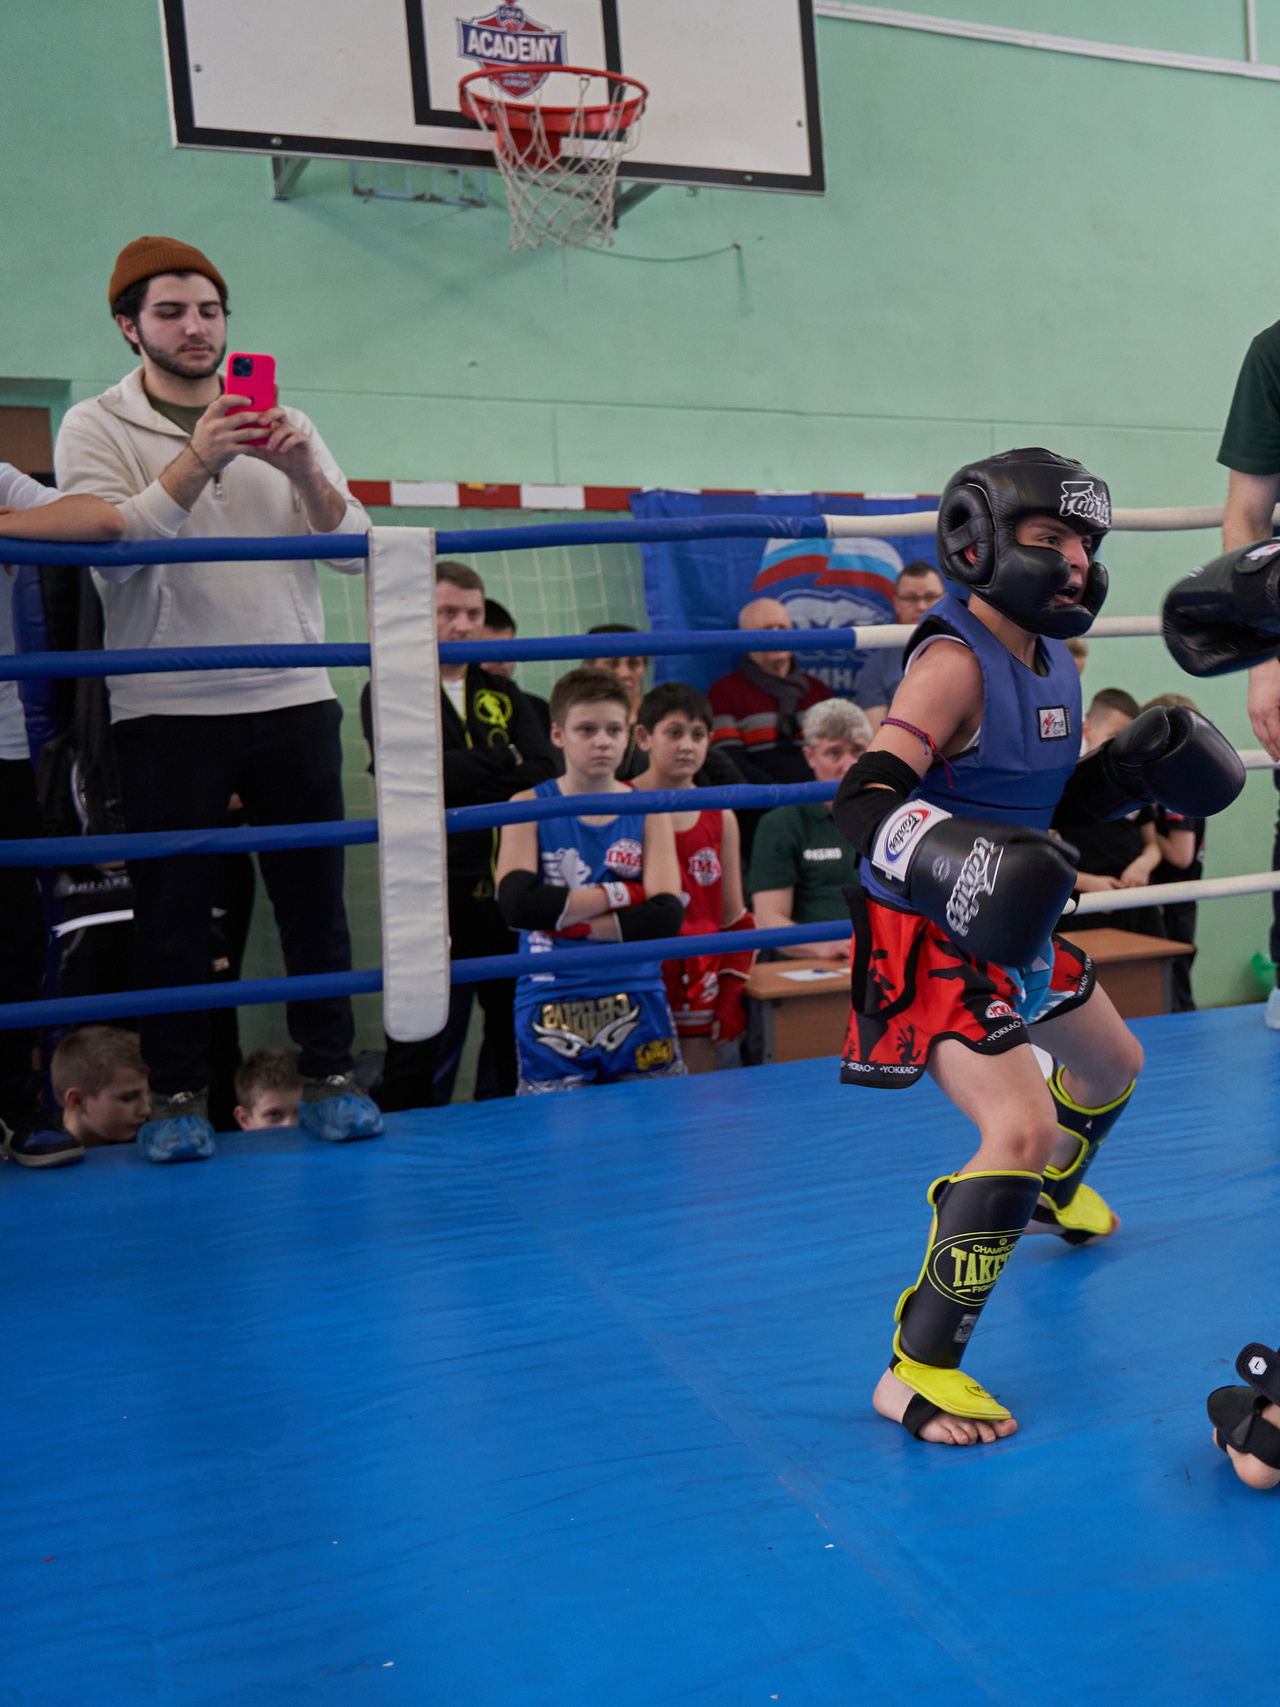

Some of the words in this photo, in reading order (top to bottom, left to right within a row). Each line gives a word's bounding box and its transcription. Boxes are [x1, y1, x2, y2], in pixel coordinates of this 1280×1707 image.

[466, 28, 558, 63] ACADEMY
[989, 1020, 1021, 1042] YOKKAO
[881, 1065, 916, 1075] YOKKAO
